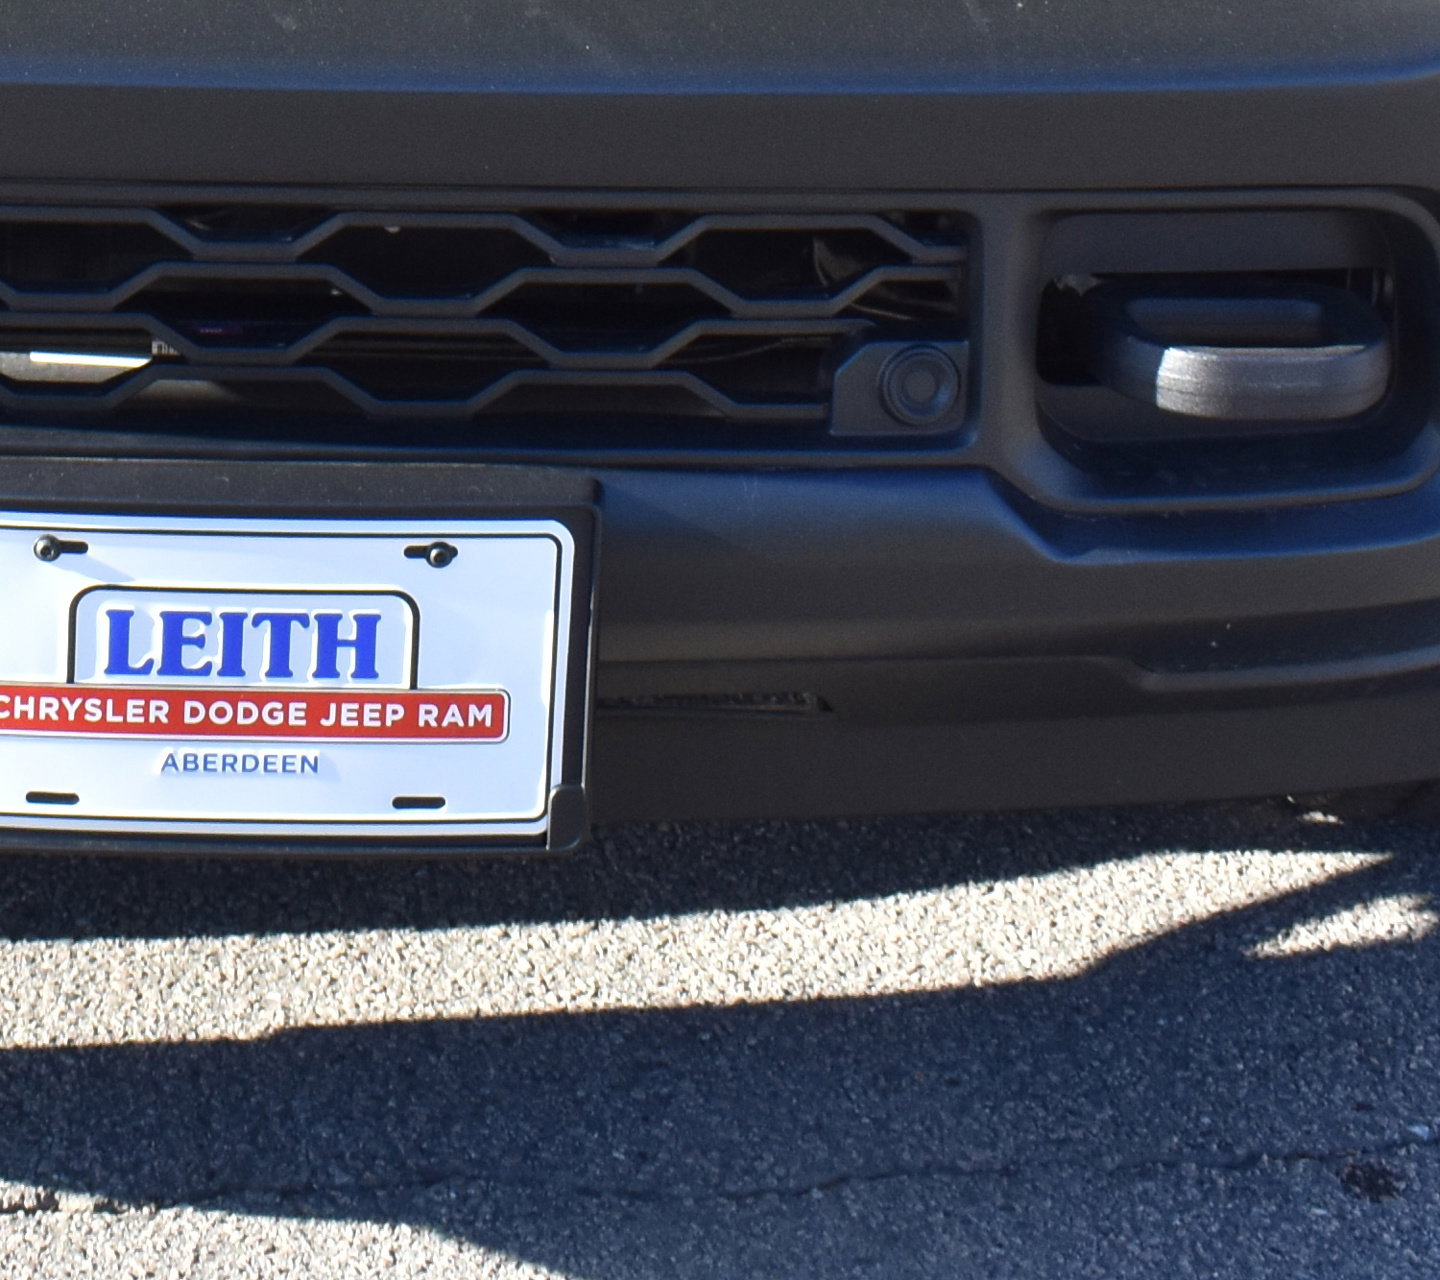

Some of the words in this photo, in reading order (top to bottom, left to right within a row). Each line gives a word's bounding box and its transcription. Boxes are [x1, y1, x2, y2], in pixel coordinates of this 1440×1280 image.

[103, 607, 383, 681] LEITH
[182, 698, 308, 727] DODGE
[320, 701, 406, 728] JEEP
[417, 703, 494, 730] RAM
[160, 751, 320, 775] ABERDEEN
